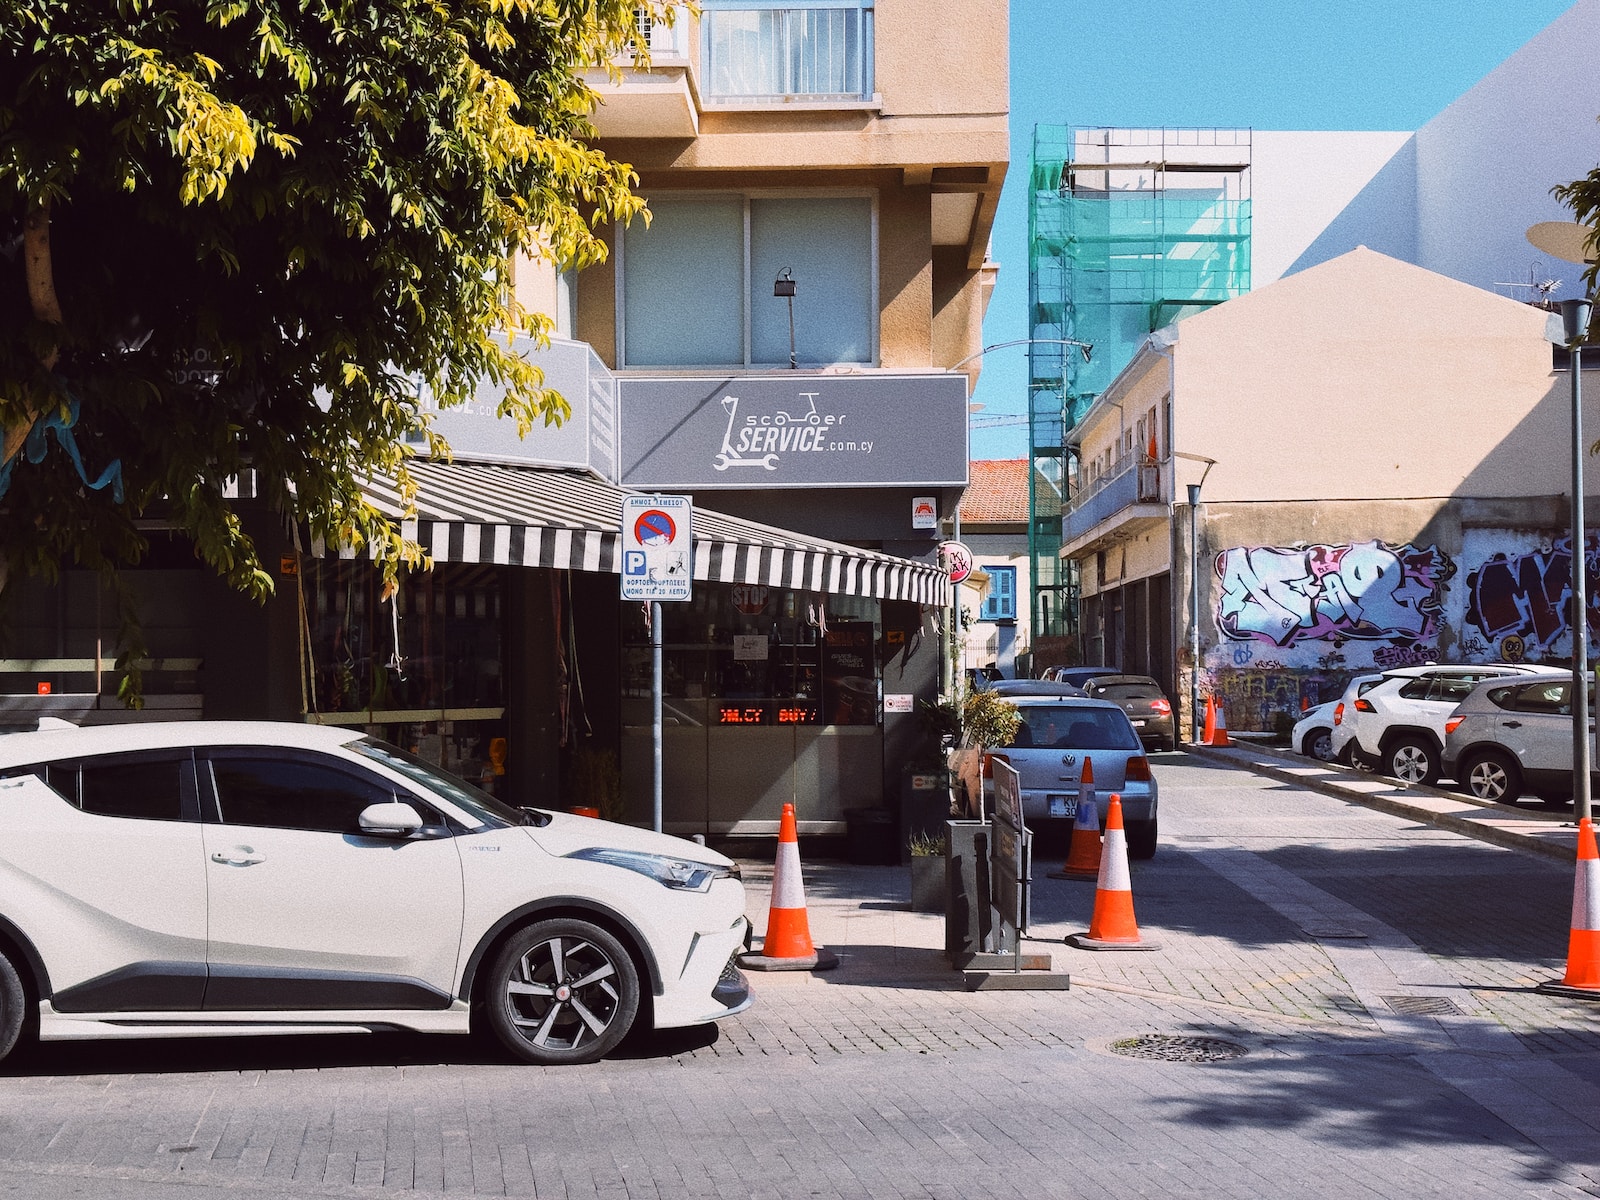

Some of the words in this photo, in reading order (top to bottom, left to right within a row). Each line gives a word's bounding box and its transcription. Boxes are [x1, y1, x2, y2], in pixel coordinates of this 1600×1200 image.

[736, 426, 829, 453] SERVICE
[628, 552, 645, 573] P
[733, 586, 768, 605] STOP
